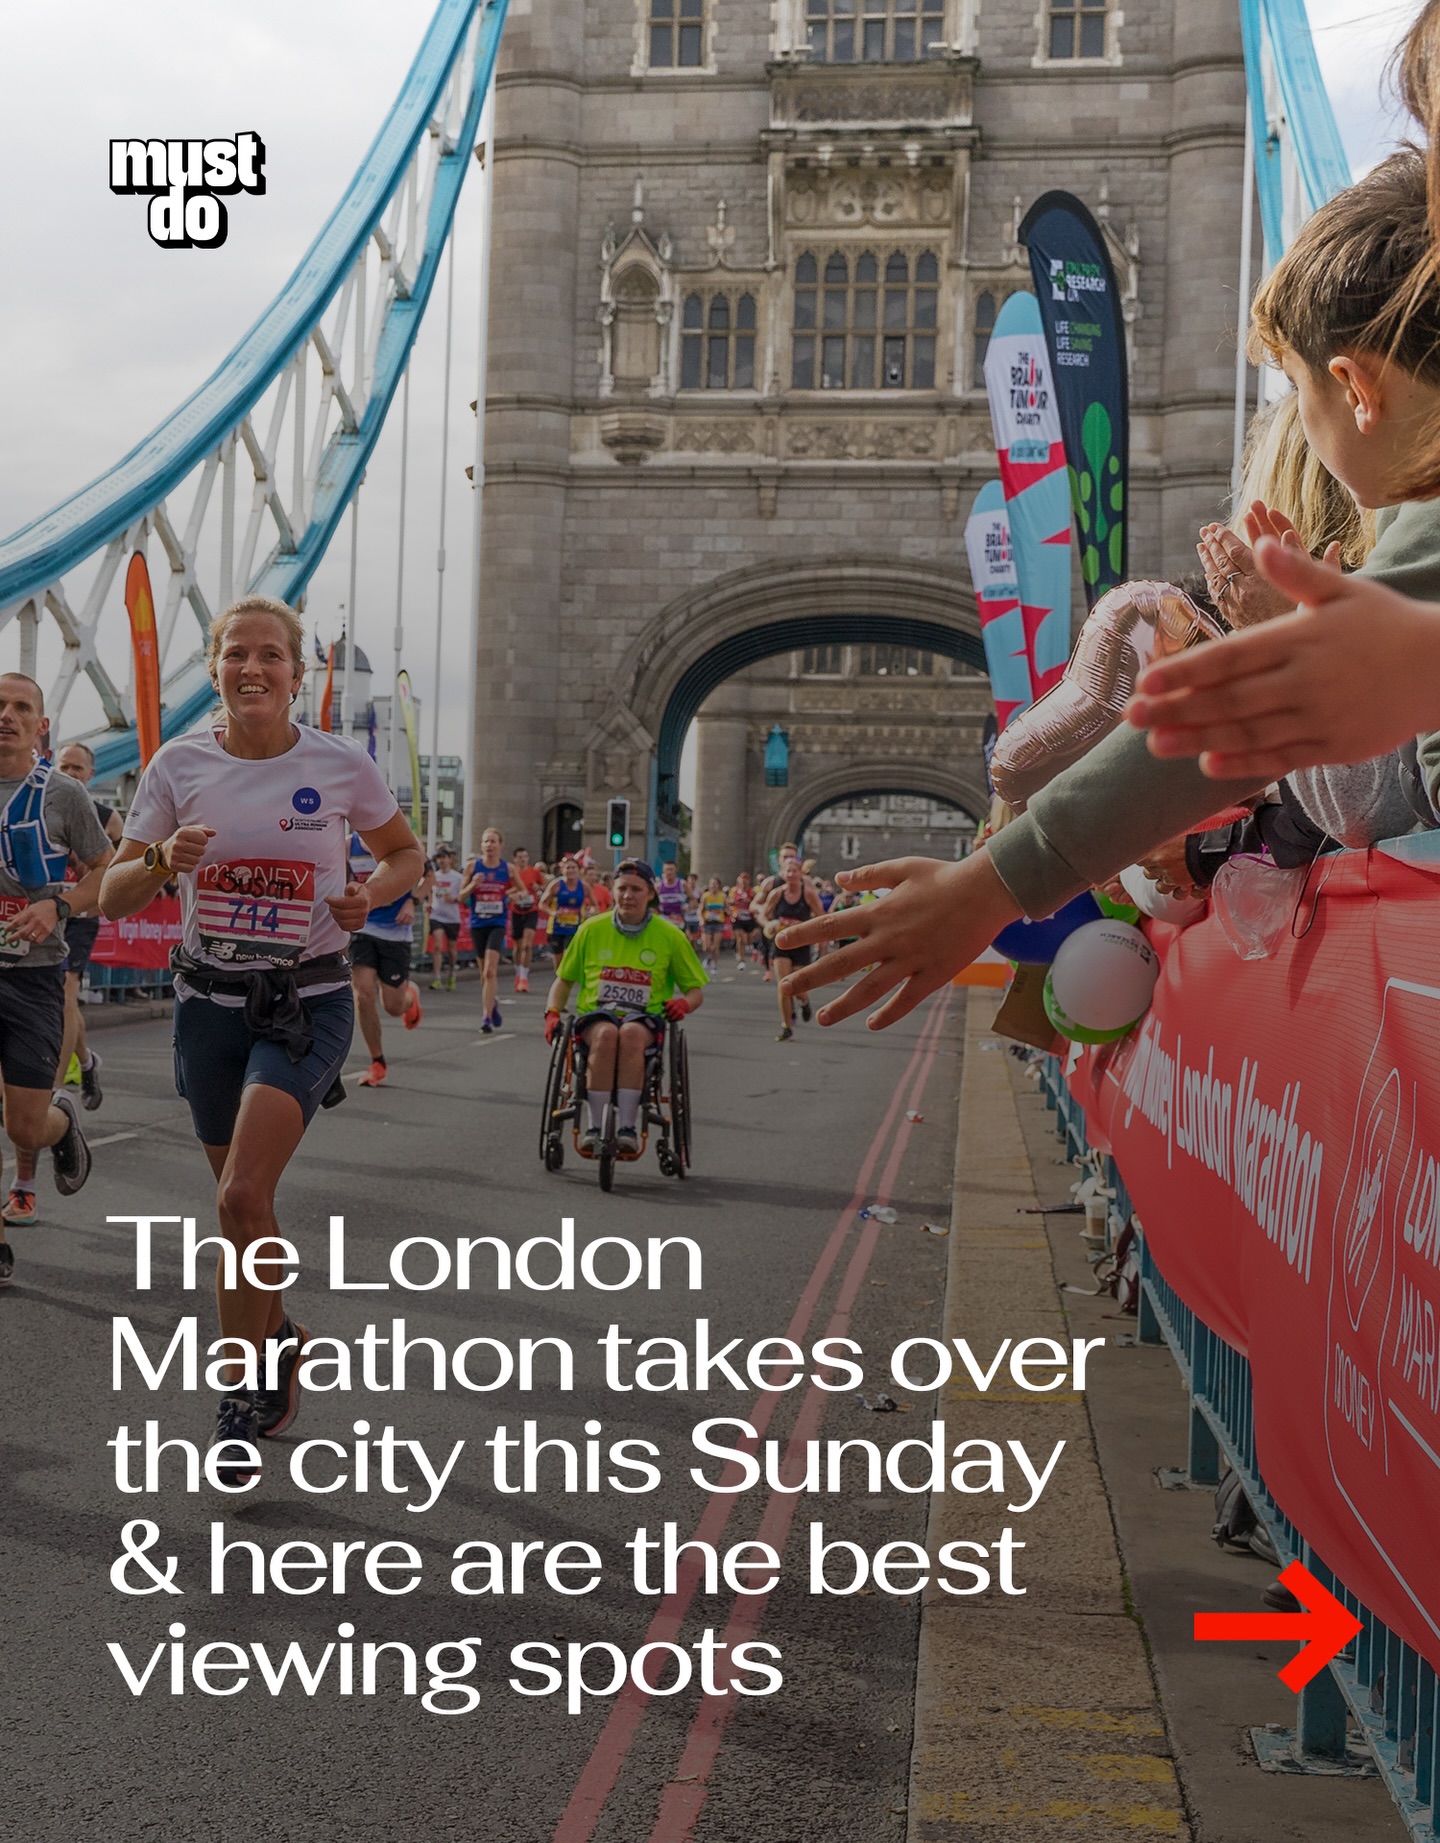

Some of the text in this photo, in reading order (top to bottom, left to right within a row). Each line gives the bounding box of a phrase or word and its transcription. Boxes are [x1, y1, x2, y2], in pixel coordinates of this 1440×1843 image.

[1065, 274, 1106, 292] RESEARCH
[1055, 320, 1069, 335] LIFE
[1056, 336, 1070, 350] LIFE
[1057, 351, 1090, 366] RESEARCH
[216, 871, 294, 901] Susan
[228, 900, 279, 932] 714
[117, 917, 139, 945] Virgin
[139, 918, 162, 945] Money
[603, 984, 644, 1003] 25208
[1175, 1033, 1232, 1186] London
[1233, 1056, 1323, 1285] Marathon
[1391, 1272, 1440, 1415] MAR
